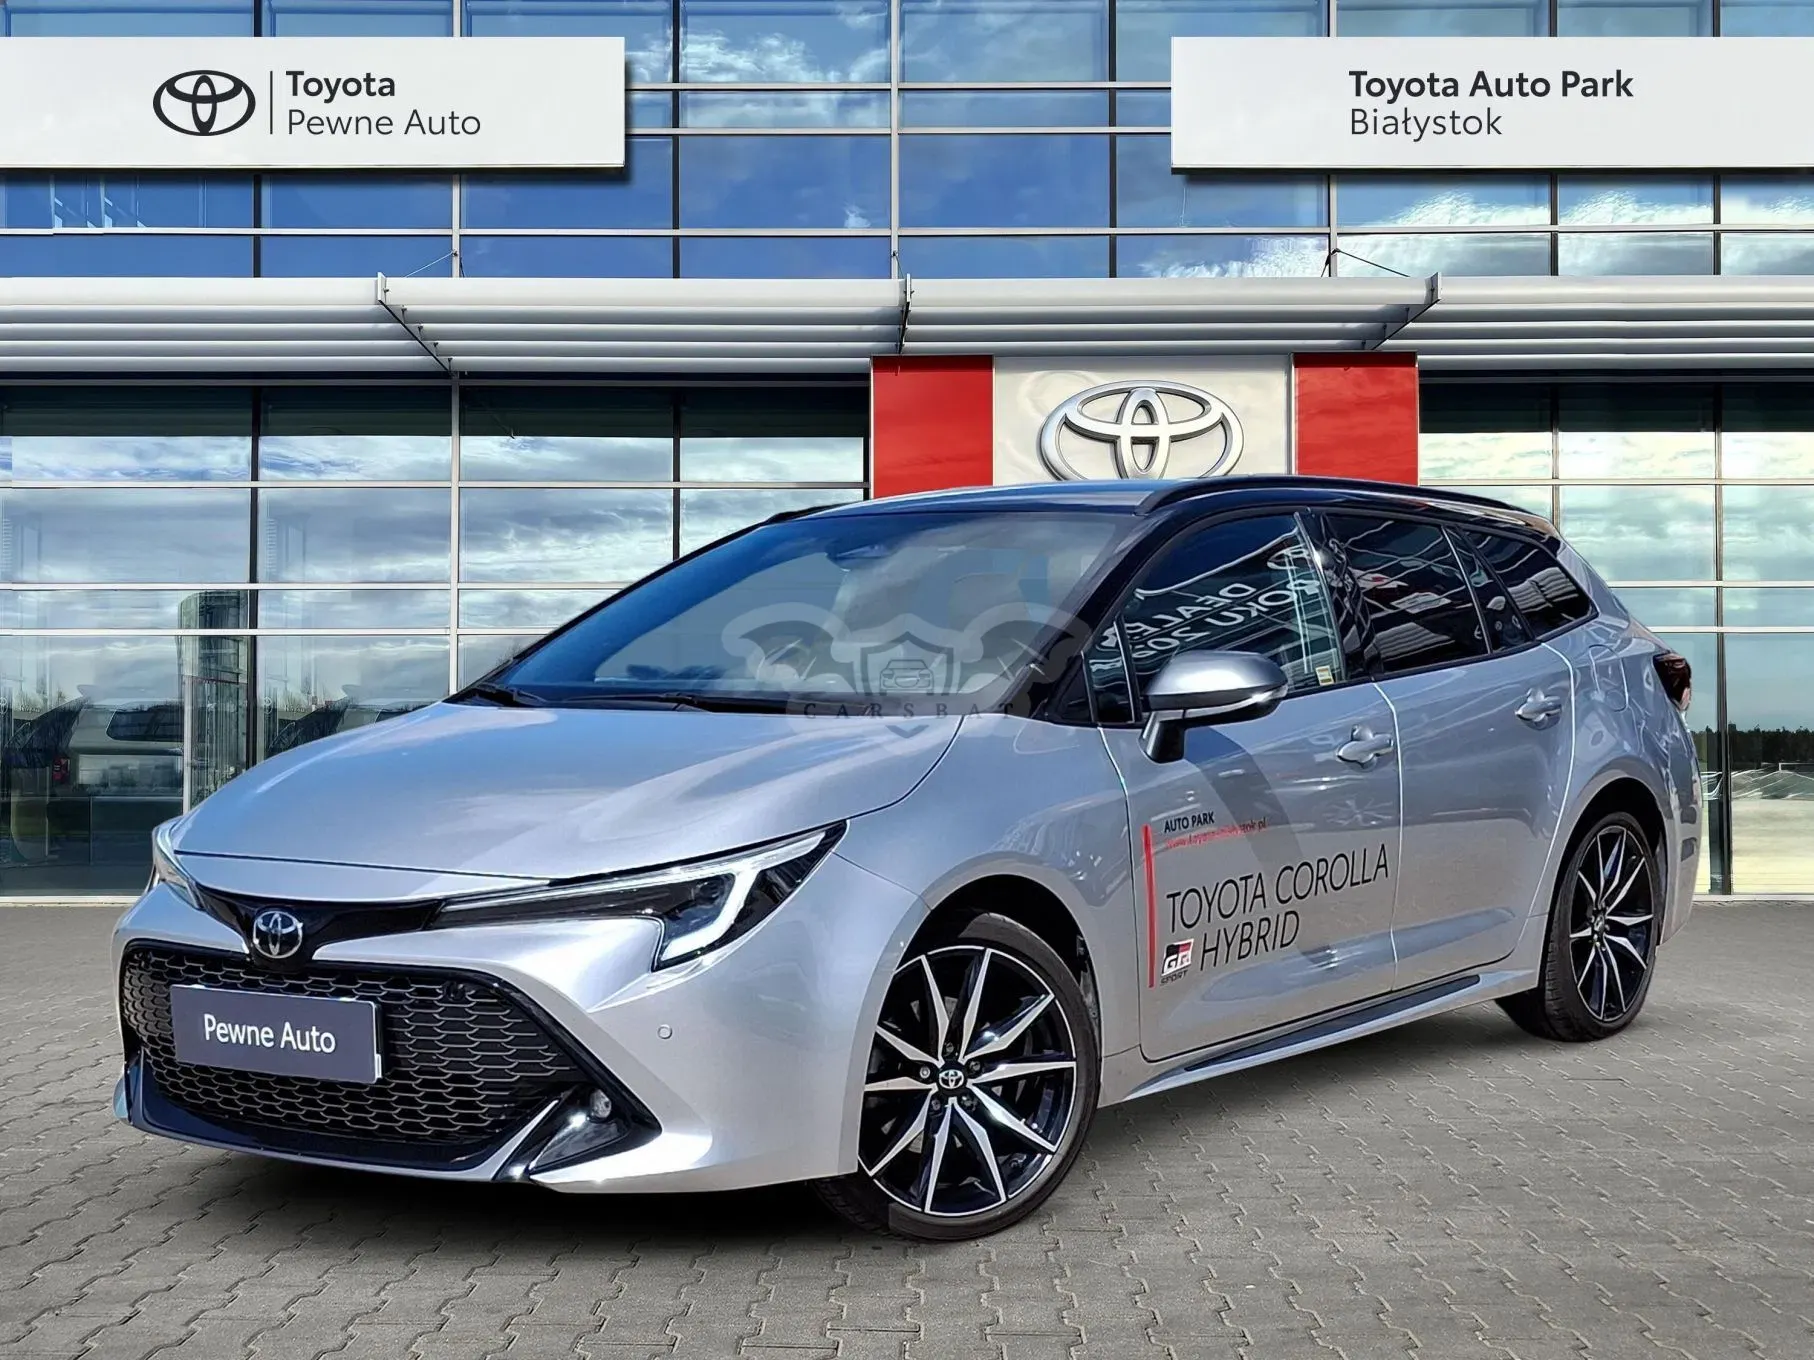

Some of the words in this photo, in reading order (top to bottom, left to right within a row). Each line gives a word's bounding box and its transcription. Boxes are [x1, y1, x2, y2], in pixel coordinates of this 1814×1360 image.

[286, 71, 395, 103] Toyota
[1349, 70, 1458, 104] Toyota
[1469, 70, 1551, 98] Auto
[1561, 69, 1634, 98] Park
[288, 109, 394, 136] Pewne
[404, 109, 481, 136] Auto
[1351, 107, 1503, 142] Białystok
[1163, 813, 1190, 833] AUTO
[1191, 811, 1215, 828] PARK
[1166, 872, 1267, 933] TOYOTA
[1276, 843, 1389, 905] COROLLA
[1200, 911, 1300, 971] HYBRID
[203, 1013, 275, 1048] Pewne
[280, 1021, 336, 1053] Auto
